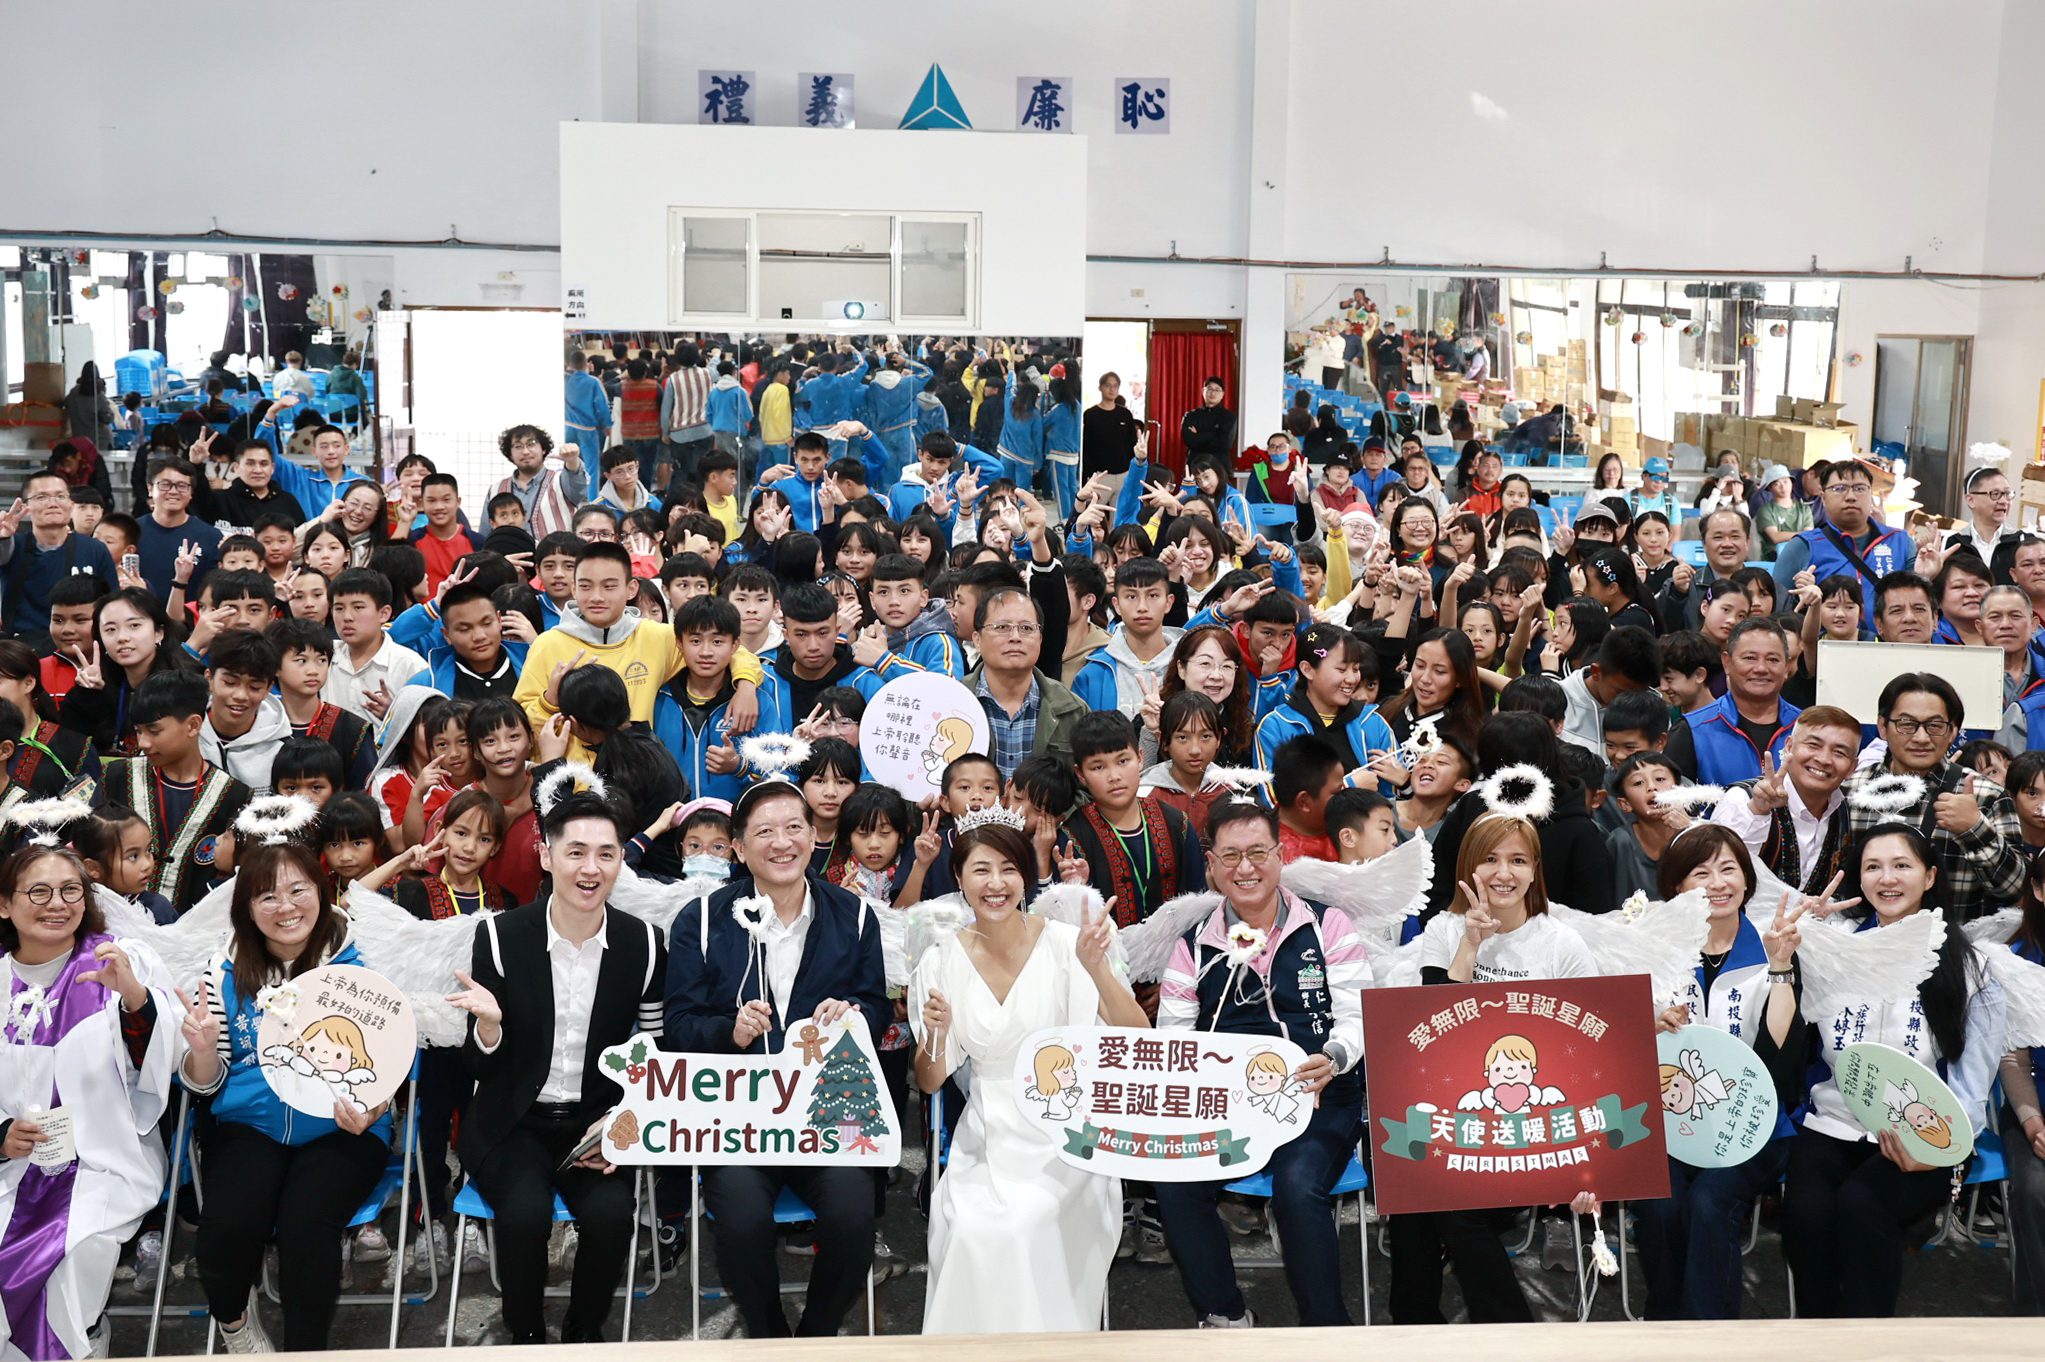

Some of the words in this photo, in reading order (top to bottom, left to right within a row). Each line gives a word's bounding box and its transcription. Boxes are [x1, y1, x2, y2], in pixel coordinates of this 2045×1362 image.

[704, 74, 751, 125] 禮
[804, 75, 845, 127] 義
[1020, 79, 1065, 131] 廉
[1121, 82, 1166, 129] 恥
[884, 692, 921, 711] 無論在
[872, 726, 921, 746] 上帝聆聽
[875, 744, 911, 761] 你聲音
[315, 991, 387, 1031] 最好的道路
[319, 973, 403, 1016] 上帝為你預備
[646, 1058, 802, 1115] Merry
[1090, 1081, 1230, 1121] 聖誕星願
[1430, 1104, 1608, 1146] 天使送暖活動
[1714, 1066, 1759, 1158] 你是上帝的珍寶
[642, 1118, 840, 1154] Christmas
[1097, 1131, 1141, 1155] Merry
[1143, 1138, 1219, 1155] Christmas
[1450, 1149, 1585, 1168] CHRISTMAS
